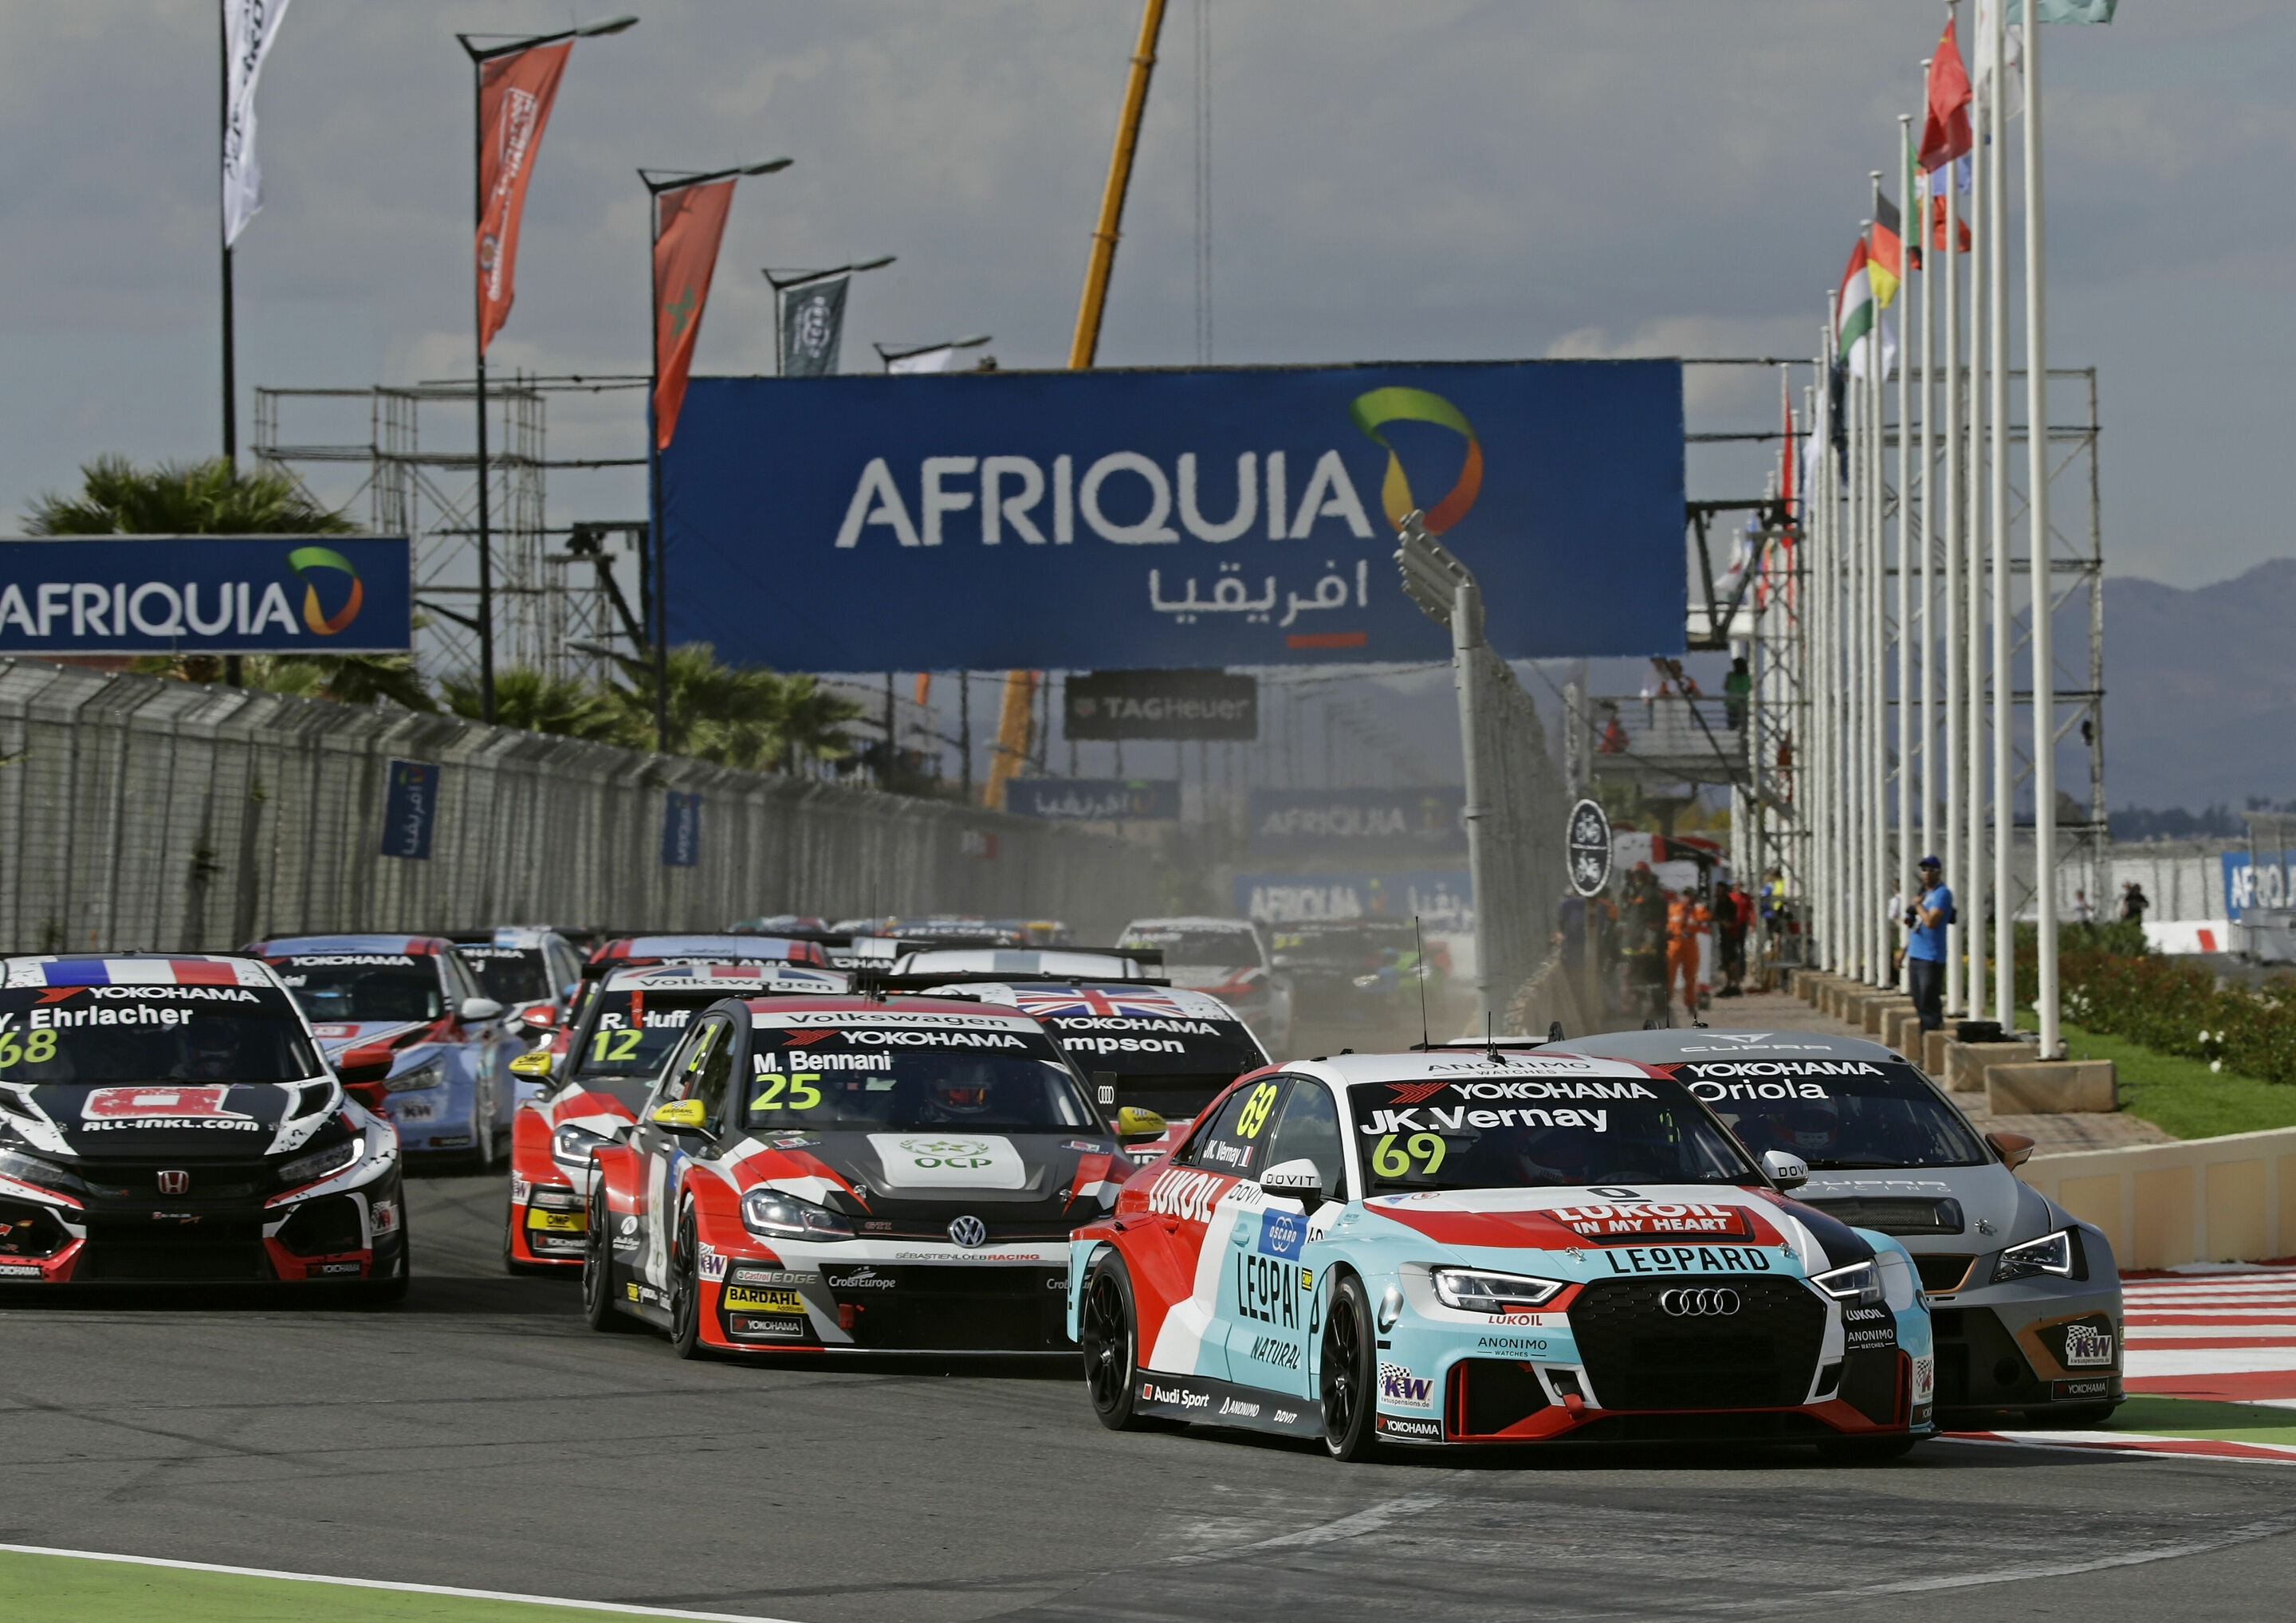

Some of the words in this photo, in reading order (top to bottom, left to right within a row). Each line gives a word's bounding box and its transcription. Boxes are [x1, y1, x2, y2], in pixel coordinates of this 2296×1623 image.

[835, 449, 1375, 548] AFRIQUIA
[1148, 560, 1368, 627] افريقيا
[0, 581, 300, 637] AFRIQUIA
[292, 956, 415, 967] YOKOHAMA
[640, 977, 833, 991] Volkswagen
[88, 987, 261, 1003] YOKOHAMA
[30, 1004, 194, 1030] Ehrlacher
[600, 1012, 627, 1031] R.
[788, 1013, 1009, 1028] Volkswagen
[1052, 1018, 1221, 1036] YOKOHAMA
[0, 1029, 57, 1068] 68
[593, 1029, 643, 1062] 12
[840, 1031, 1028, 1049] YOKOHAMA
[753, 1052, 784, 1074] M.
[789, 1050, 892, 1071] Bennani
[1428, 1062, 1591, 1072] ANONIMO
[1686, 1062, 1885, 1077] YOKOHAMA
[749, 1074, 821, 1110] 25
[1449, 1083, 1659, 1100] YOKOHAMA
[1688, 1079, 1830, 1102] Oriola
[1236, 1082, 1278, 1139] 69
[1359, 1105, 1608, 1135] JK.Vernay
[914, 1158, 993, 1169] OCP
[1216, 1140, 1241, 1169] Vernay
[1371, 1132, 1448, 1178] 69
[1266, 1173, 1316, 1186] DOVIT
[1148, 1169, 1224, 1224] LUKOIL
[547, 1215, 571, 1225] OMP
[1552, 1204, 1733, 1220] LUKOIL
[864, 1221, 892, 1230] GTI
[1269, 1225, 1298, 1243] OSCARO
[1573, 1221, 1602, 1234] IN
[1609, 1220, 1645, 1232] MY
[1653, 1218, 1728, 1231] HEART
[1605, 1247, 1771, 1274] LEOPARD
[743, 1272, 770, 1282] Castrol
[770, 1272, 818, 1284] EDGE
[730, 1288, 800, 1306] BARDAHL
[1488, 1315, 1543, 1326] LUKOIL
[1846, 1309, 1885, 1321] LUKOIL
[747, 1320, 800, 1332] YOKOHAMA
[1477, 1337, 1547, 1350] ANONIMO
[1848, 1329, 1894, 1342] ANONIMO
[2075, 1337, 2111, 1358] KW
[1154, 1385, 1180, 1404] Audi
[1181, 1389, 1210, 1409] Sport
[1385, 1375, 1433, 1401] KW
[2068, 1382, 2105, 1394] YOKOHAMA
[1228, 1401, 1260, 1417] ANONIMO
[1386, 1419, 1440, 1435] YOKOHAMA
